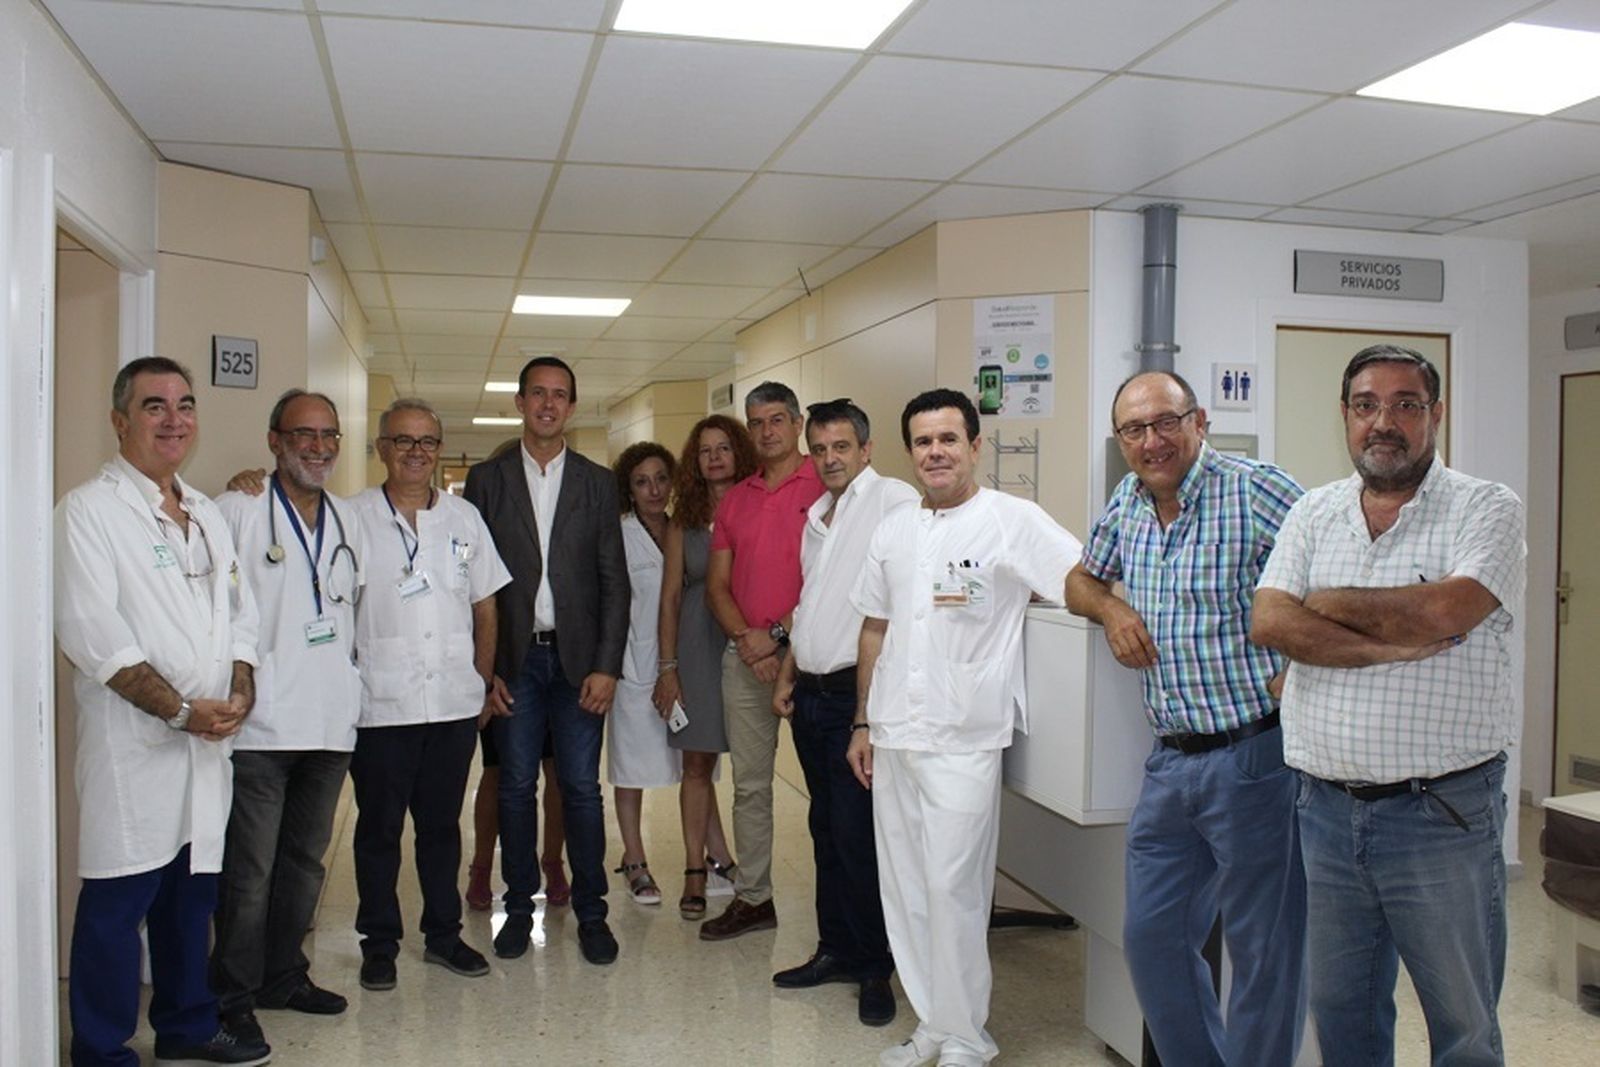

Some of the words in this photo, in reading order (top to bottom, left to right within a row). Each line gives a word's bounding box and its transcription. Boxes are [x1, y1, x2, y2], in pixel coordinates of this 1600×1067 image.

[1340, 260, 1402, 276] SERVICIOS
[1341, 275, 1401, 291] PRIVADOS
[221, 351, 253, 375] 525
